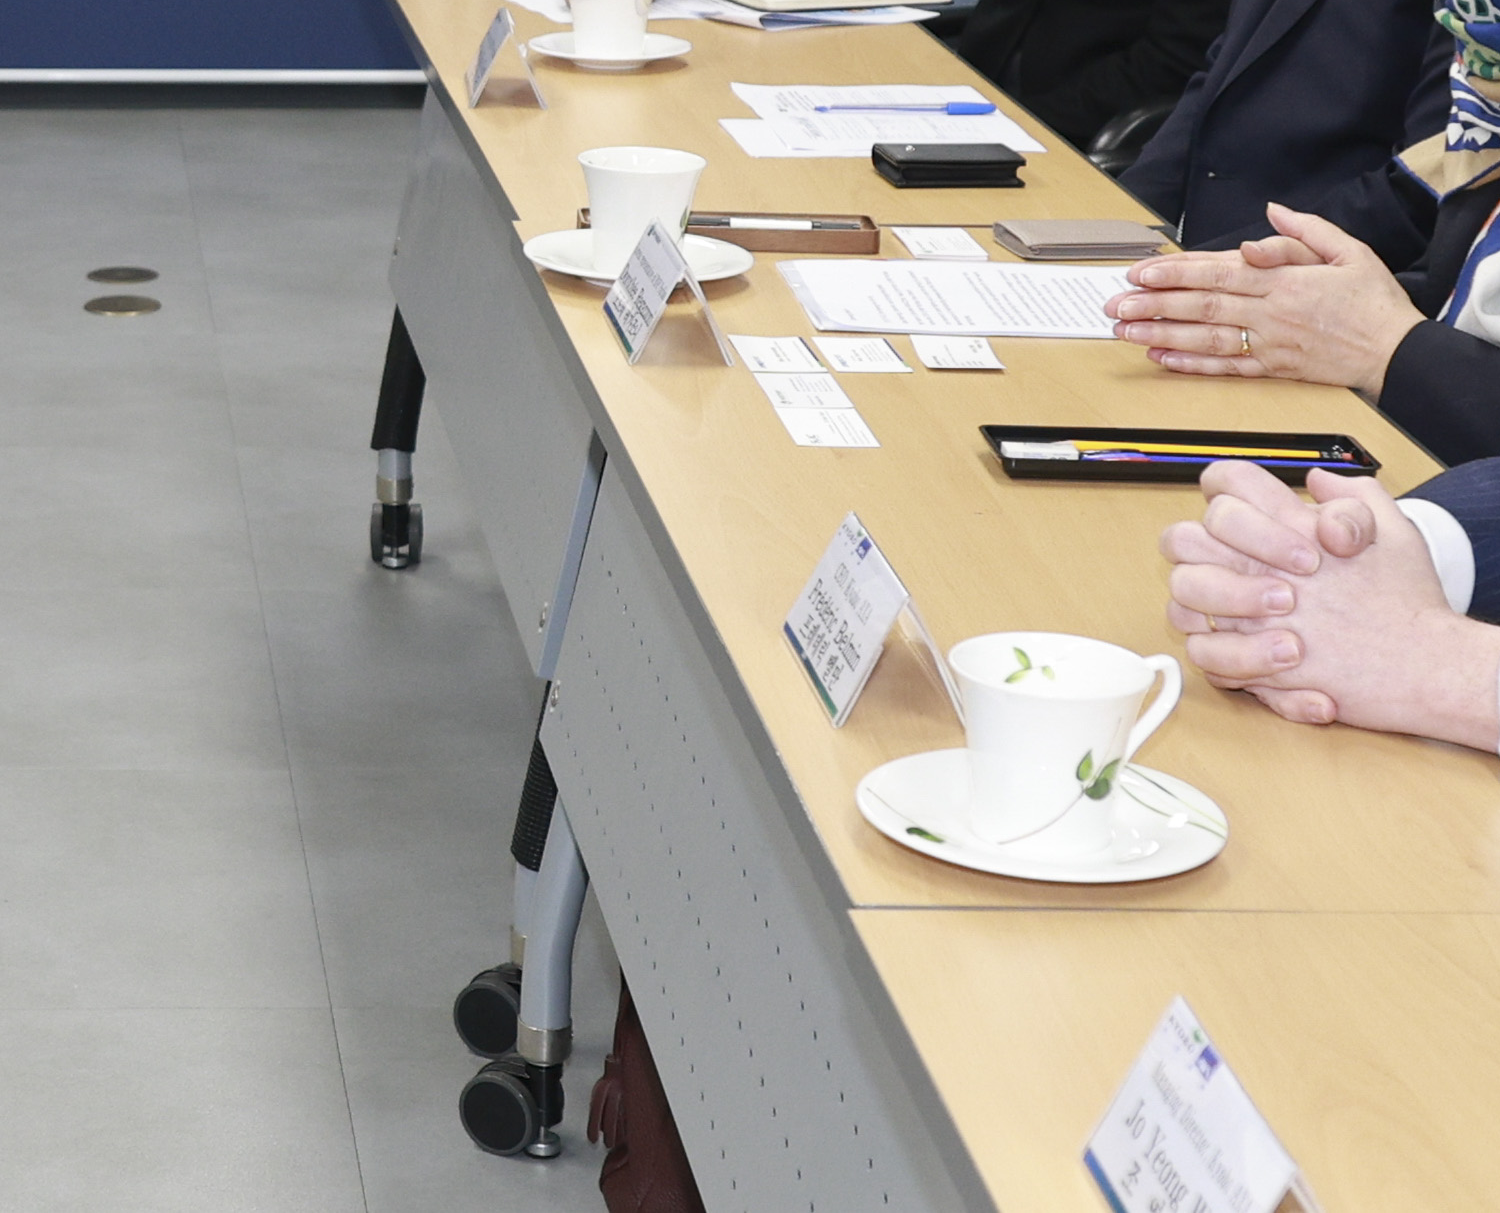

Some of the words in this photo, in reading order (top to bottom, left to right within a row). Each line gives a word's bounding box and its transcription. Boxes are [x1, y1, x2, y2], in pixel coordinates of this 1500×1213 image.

[808, 578, 839, 633] Frédéric
[833, 620, 862, 672] Belmin
[1125, 1098, 1146, 1140] Jo
[1144, 1125, 1189, 1210] Yeong
